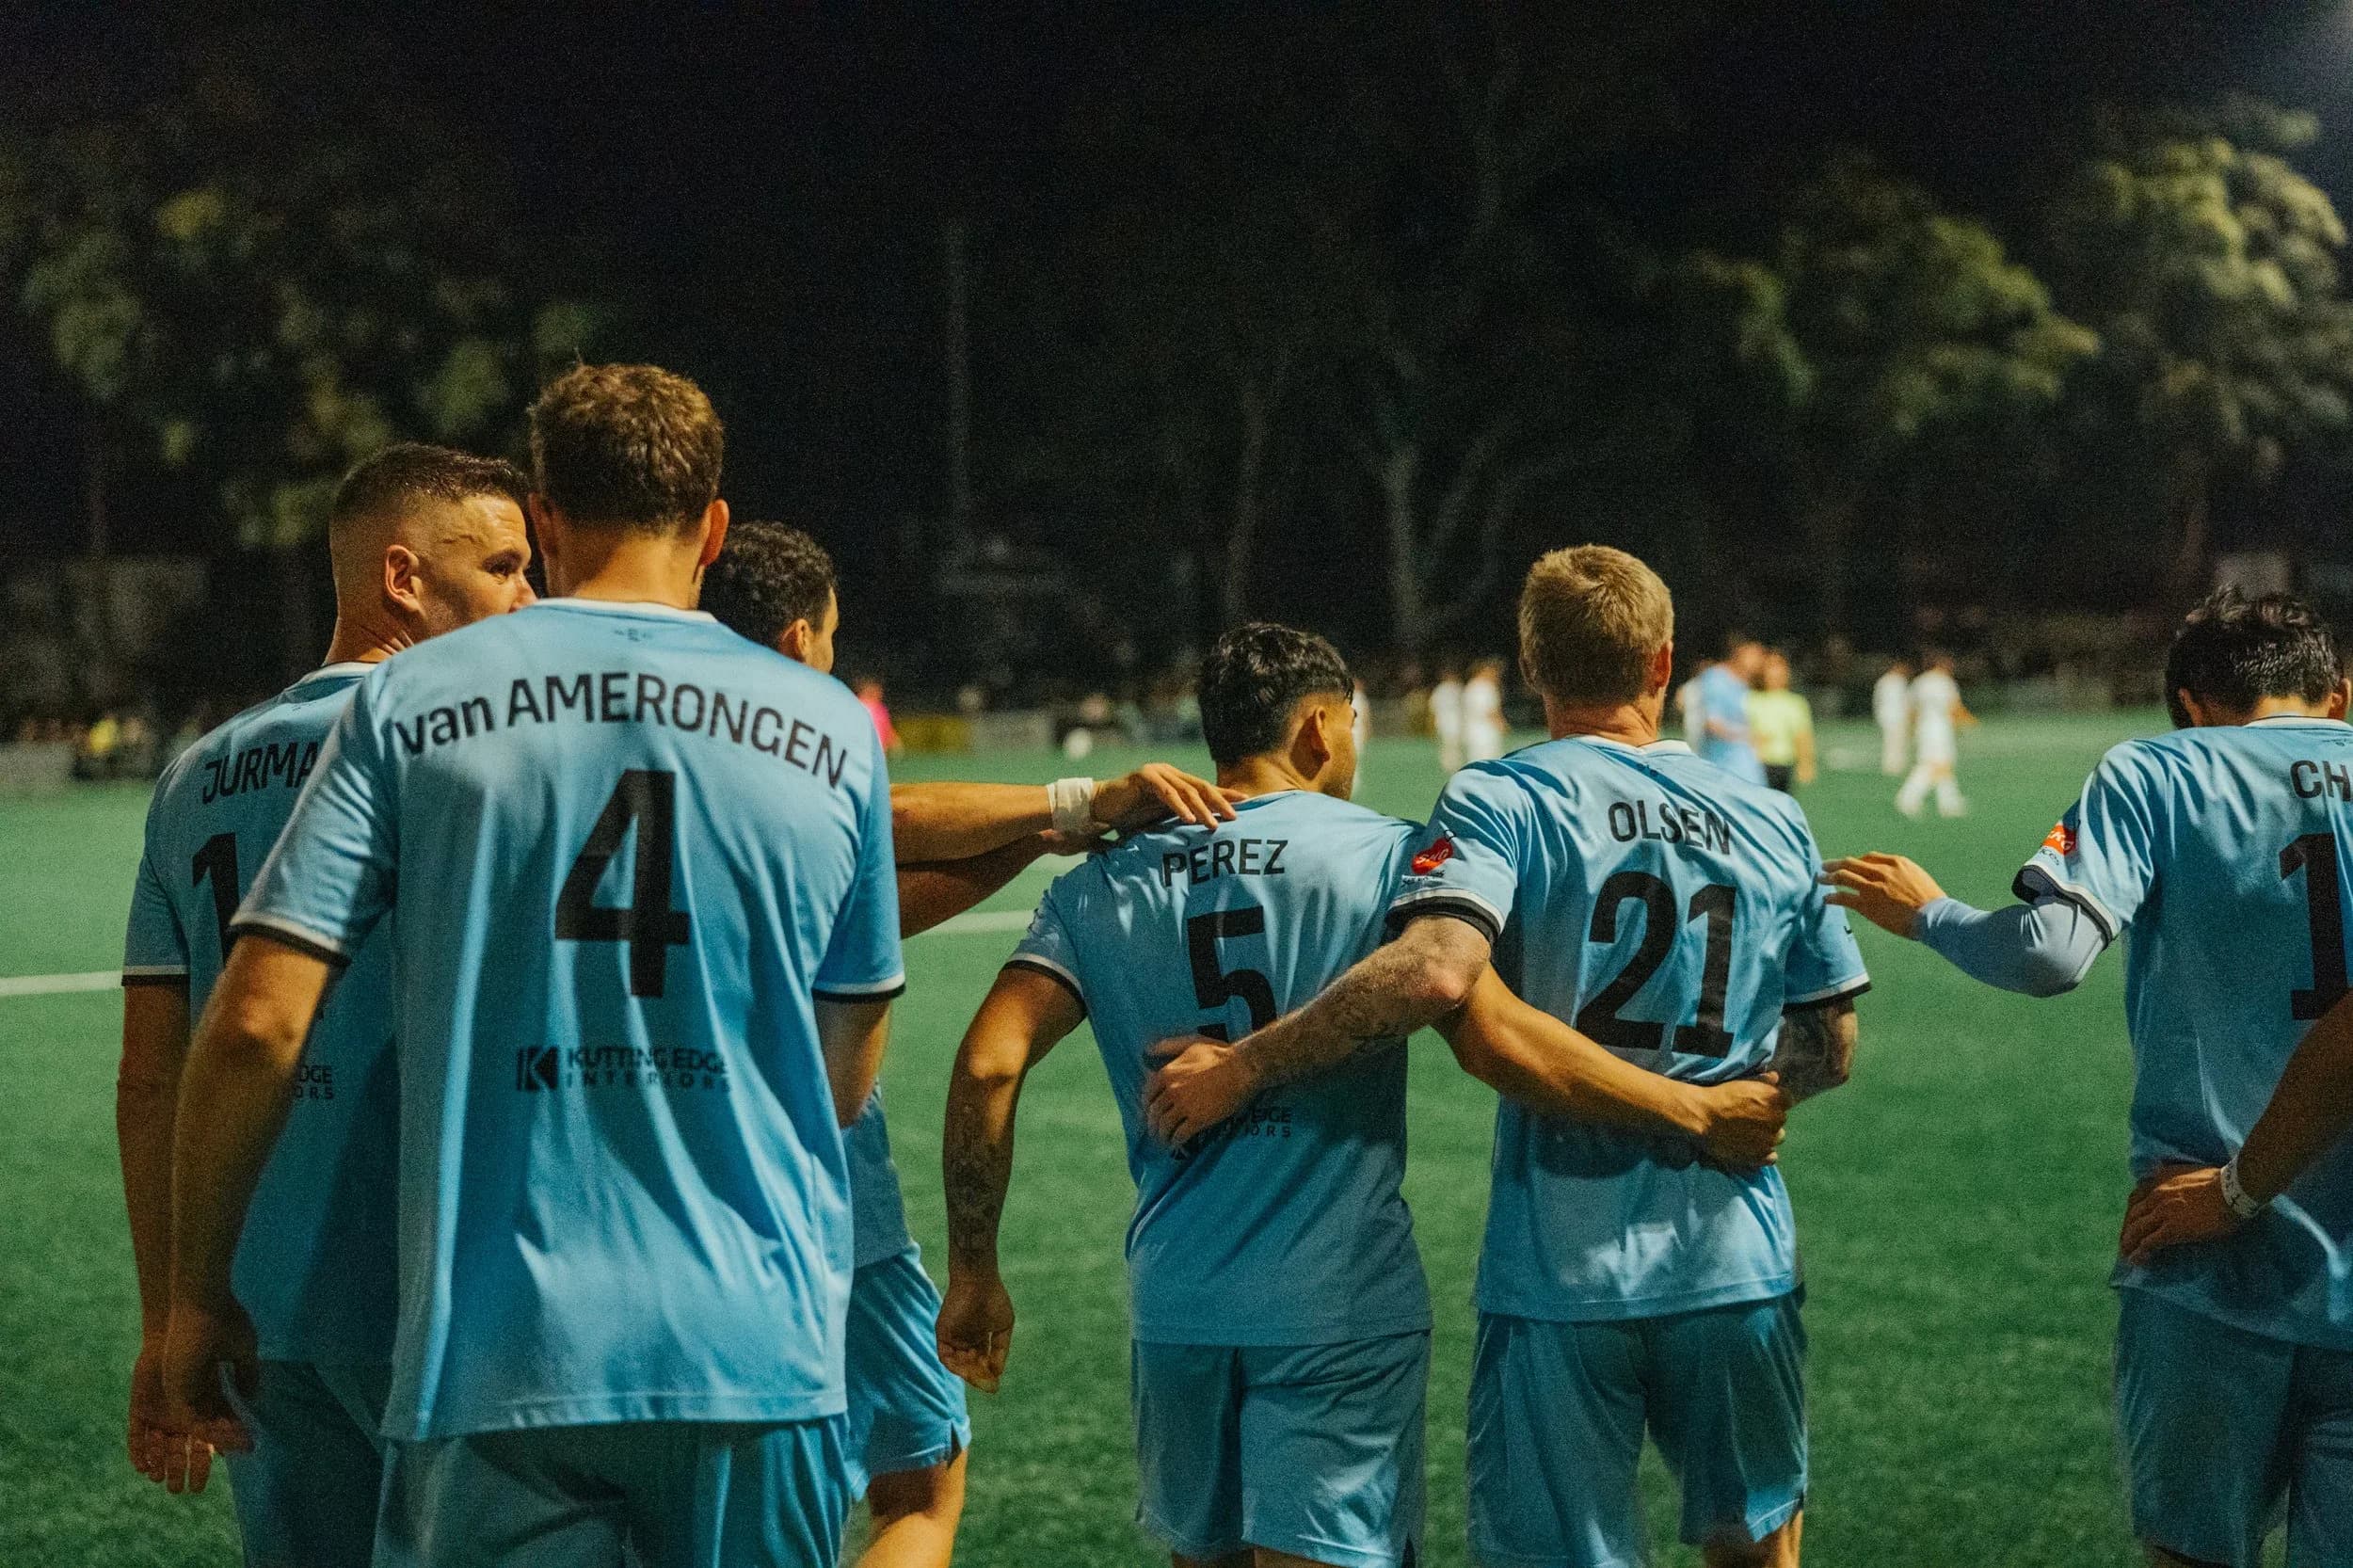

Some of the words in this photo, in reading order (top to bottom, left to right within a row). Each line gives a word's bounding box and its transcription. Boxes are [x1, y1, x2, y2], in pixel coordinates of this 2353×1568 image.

[395, 696, 494, 756] van
[507, 672, 847, 789] AMERONGEN
[2290, 760, 2351, 802] CH
[554, 768, 691, 999] 4
[1162, 839, 1289, 887] PEREZ
[1609, 799, 1731, 855] OLSEN
[1187, 905, 1277, 1044] 5
[1577, 871, 1737, 1059] 21
